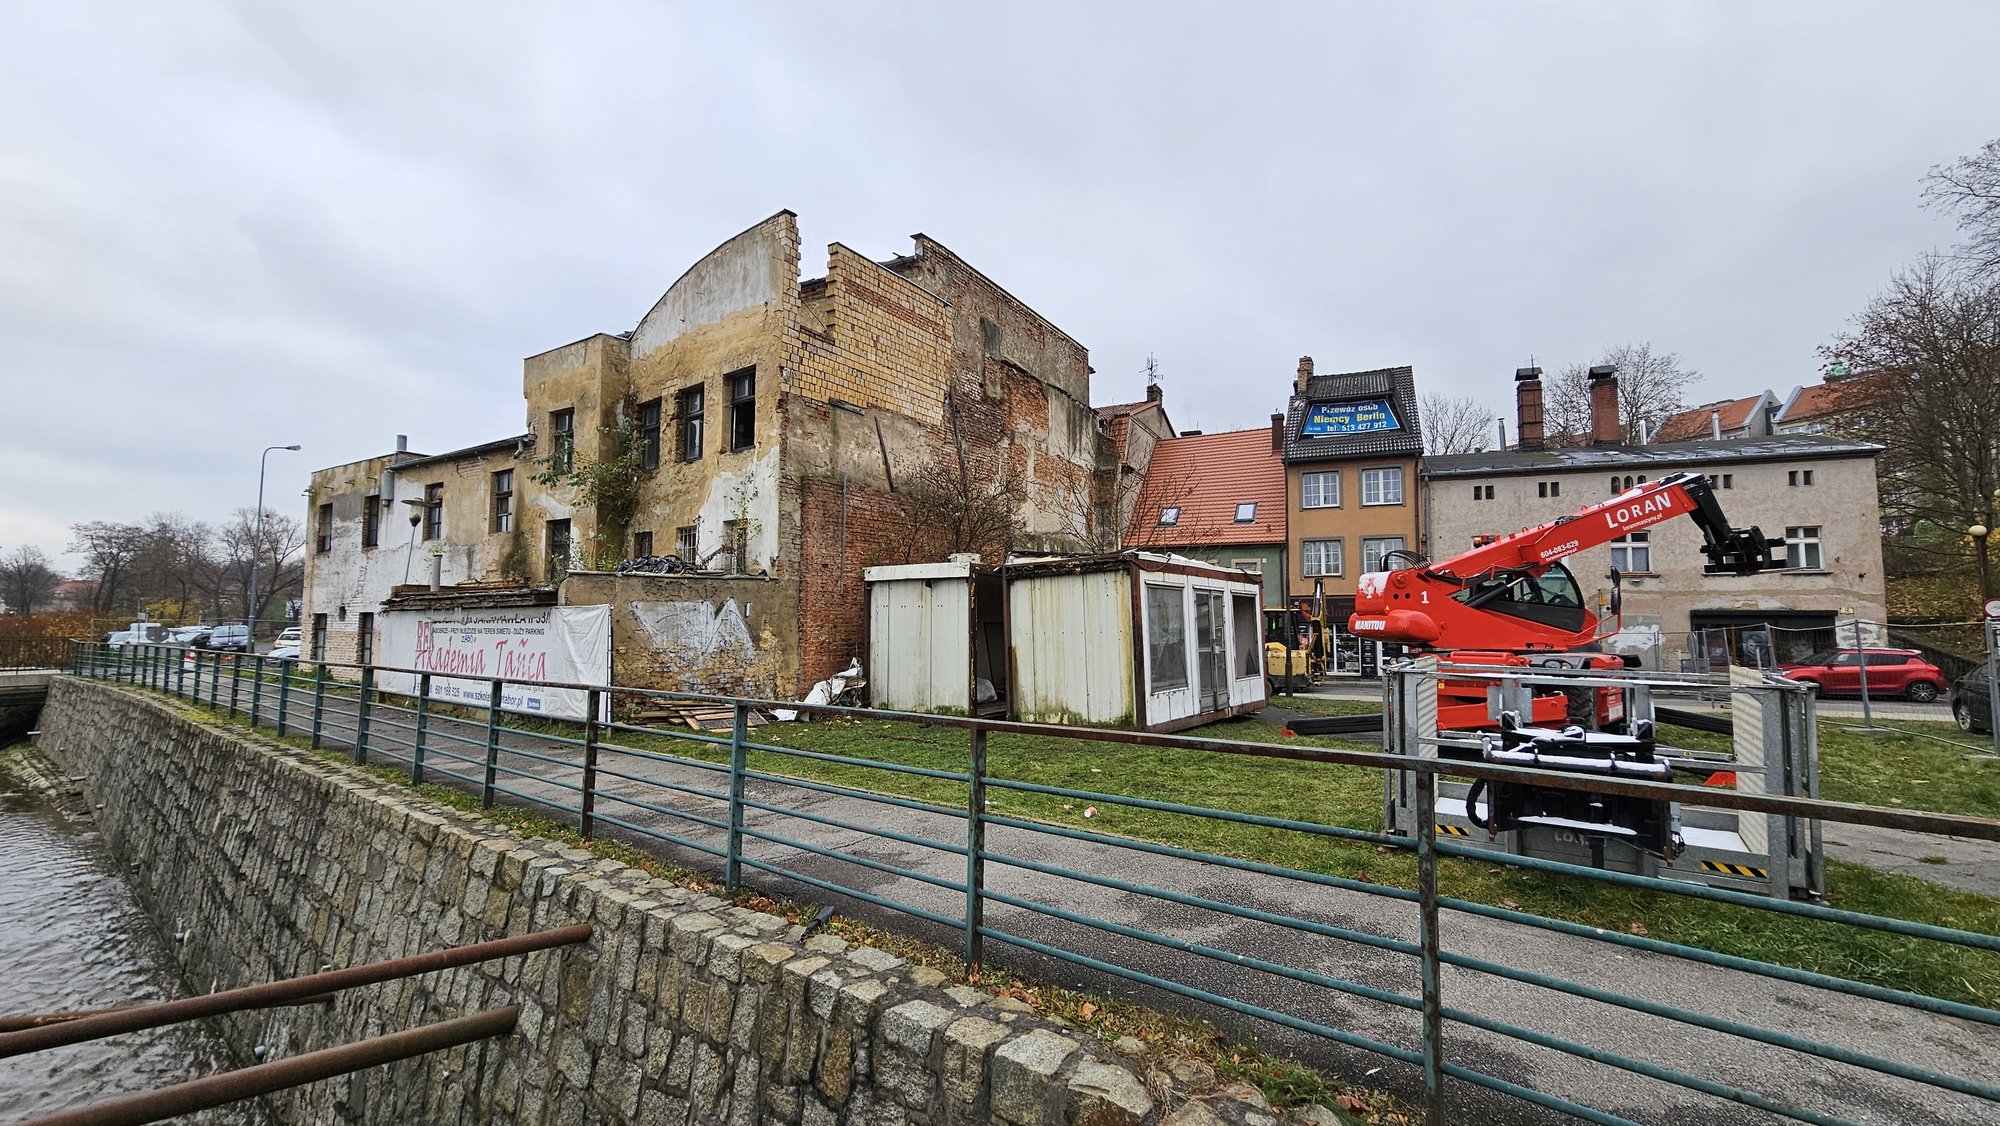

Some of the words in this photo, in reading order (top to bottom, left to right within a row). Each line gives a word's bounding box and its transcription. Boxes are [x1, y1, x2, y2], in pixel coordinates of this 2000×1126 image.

[1358, 402, 1378, 412] osób
[1314, 415, 1350, 424] Niemcy
[1356, 412, 1385, 421] Berlin
[1357, 422, 1371, 430] 427
[1373, 421, 1387, 429] 912
[1605, 491, 1672, 529] LORAN
[1622, 512, 1663, 532] loranmaszyny.pl
[1421, 590, 1430, 604] 1
[1354, 620, 1386, 631] MANITOU
[415, 635, 486, 676] Akademia
[495, 638, 546, 681] Tańca
